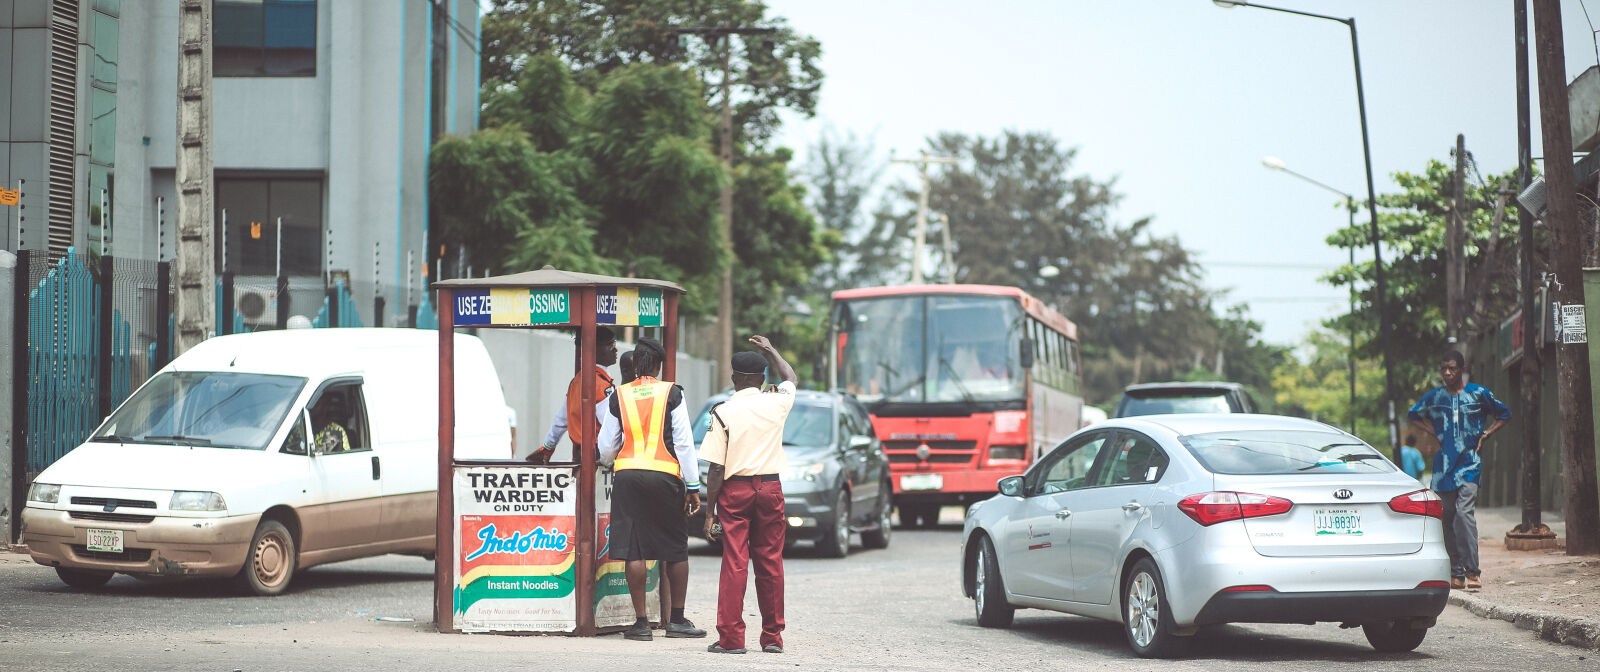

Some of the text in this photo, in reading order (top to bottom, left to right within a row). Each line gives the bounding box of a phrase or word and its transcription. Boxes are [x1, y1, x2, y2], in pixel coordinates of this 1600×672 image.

[458, 296, 477, 316] USE
[514, 293, 565, 314] CROSSING
[596, 295, 609, 314] USE
[467, 473, 570, 488] TRAFFIC
[474, 490, 564, 503] WARDEN
[487, 580, 559, 590] Instant Noodles
[608, 577, 628, 586] Instan
